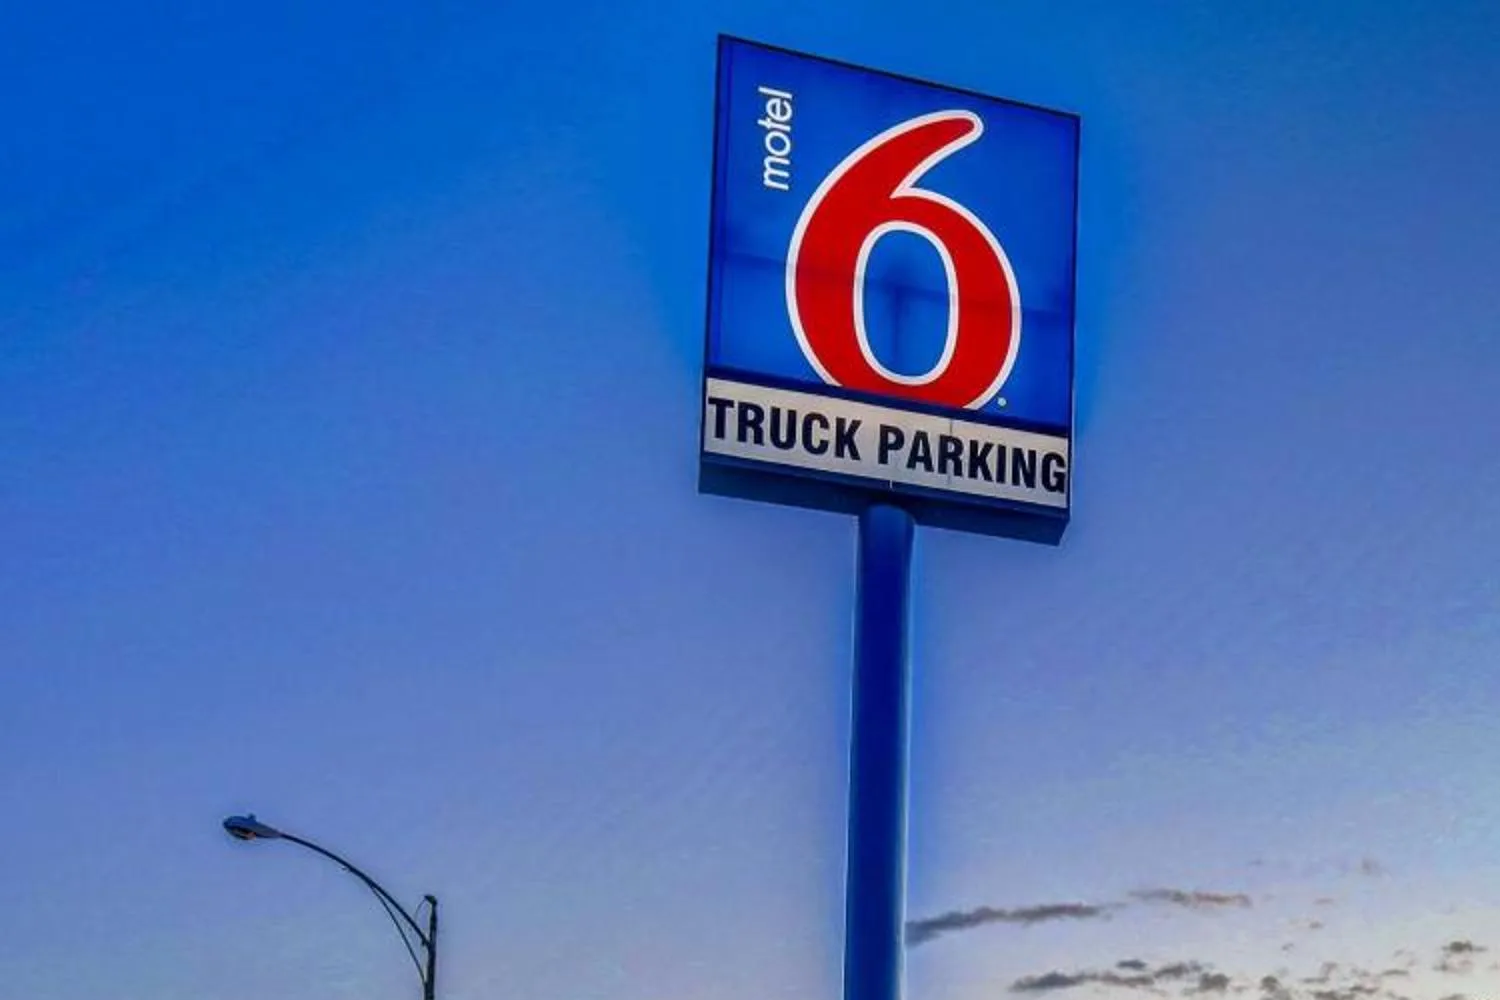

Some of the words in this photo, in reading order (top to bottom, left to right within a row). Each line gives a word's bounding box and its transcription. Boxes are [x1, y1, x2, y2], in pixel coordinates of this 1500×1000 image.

[757, 86, 793, 191] motel
[786, 109, 1021, 410] 6
[707, 397, 862, 461] TRUCK
[877, 423, 1067, 494] PARKING
